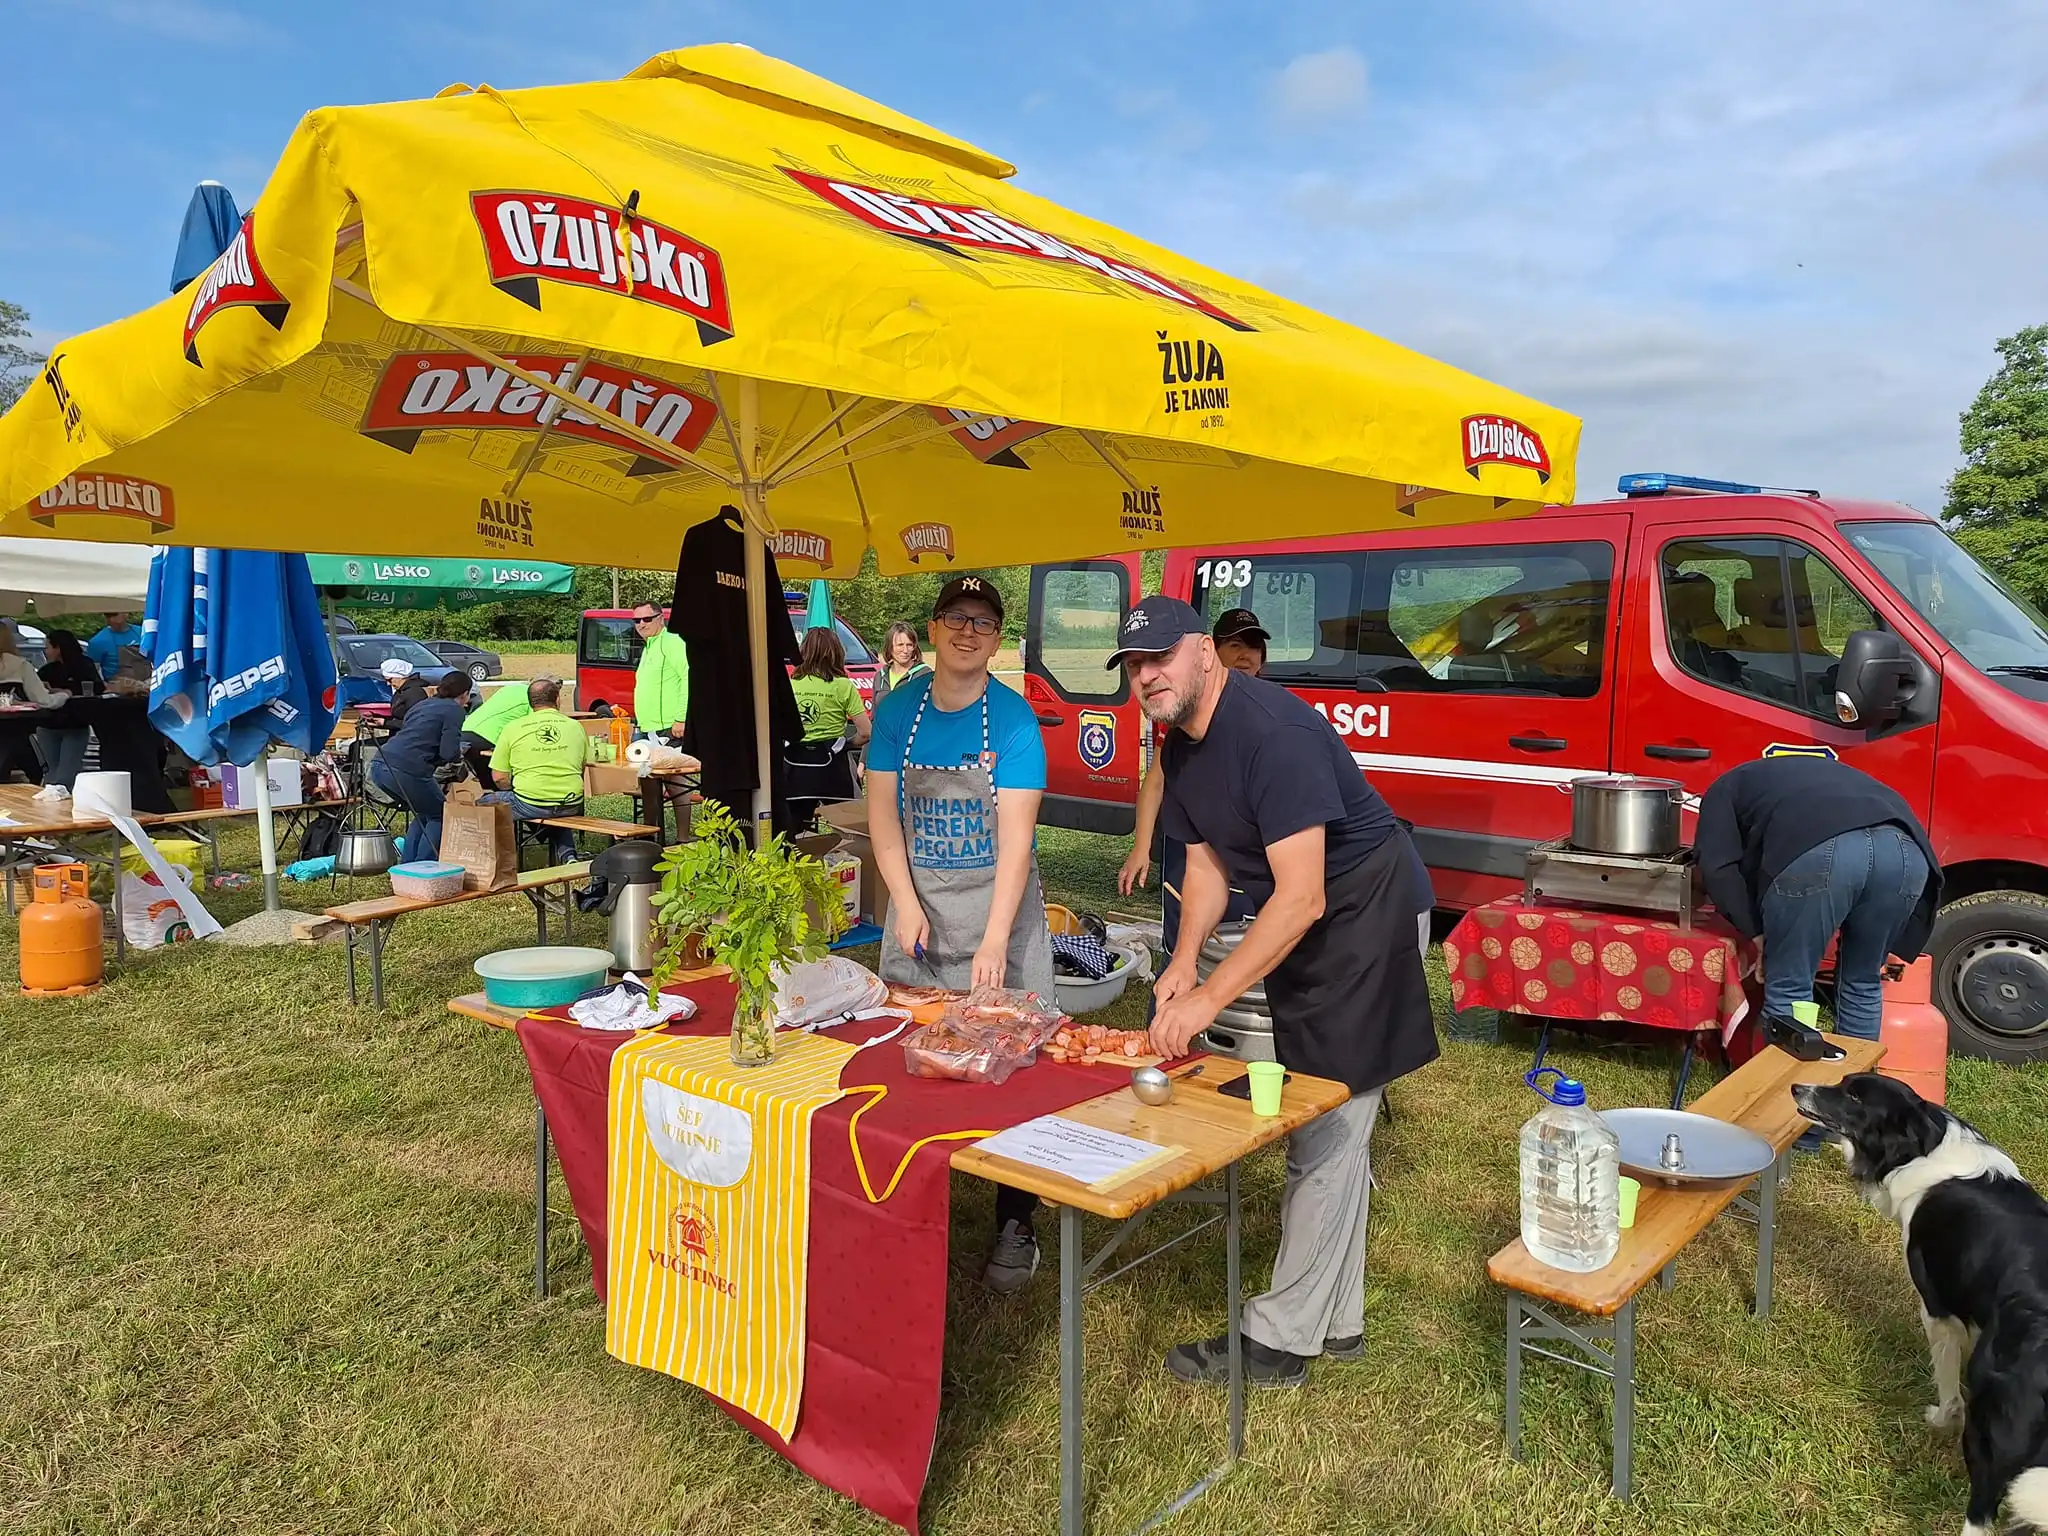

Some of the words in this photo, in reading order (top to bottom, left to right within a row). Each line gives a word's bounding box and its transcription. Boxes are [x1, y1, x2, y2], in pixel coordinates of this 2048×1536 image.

[496, 200, 710, 308] Ožujsko
[1156, 330, 1225, 384] ŽUJA
[1164, 391, 1179, 413] JE
[1182, 387, 1229, 411] ZAKON!
[1200, 416, 1209, 428] od
[1468, 418, 1541, 464] Ožujsko
[373, 562, 431, 580] LAŠKO
[492, 567, 543, 584] LAŠKO
[1197, 560, 1252, 589] 193
[210, 655, 287, 709] PEPSI
[1088, 774, 1129, 784] RENAULT
[910, 795, 990, 816] KUHAM,
[914, 836, 994, 859] PEGLAM
[648, 1248, 737, 1300] VUČETINEC
